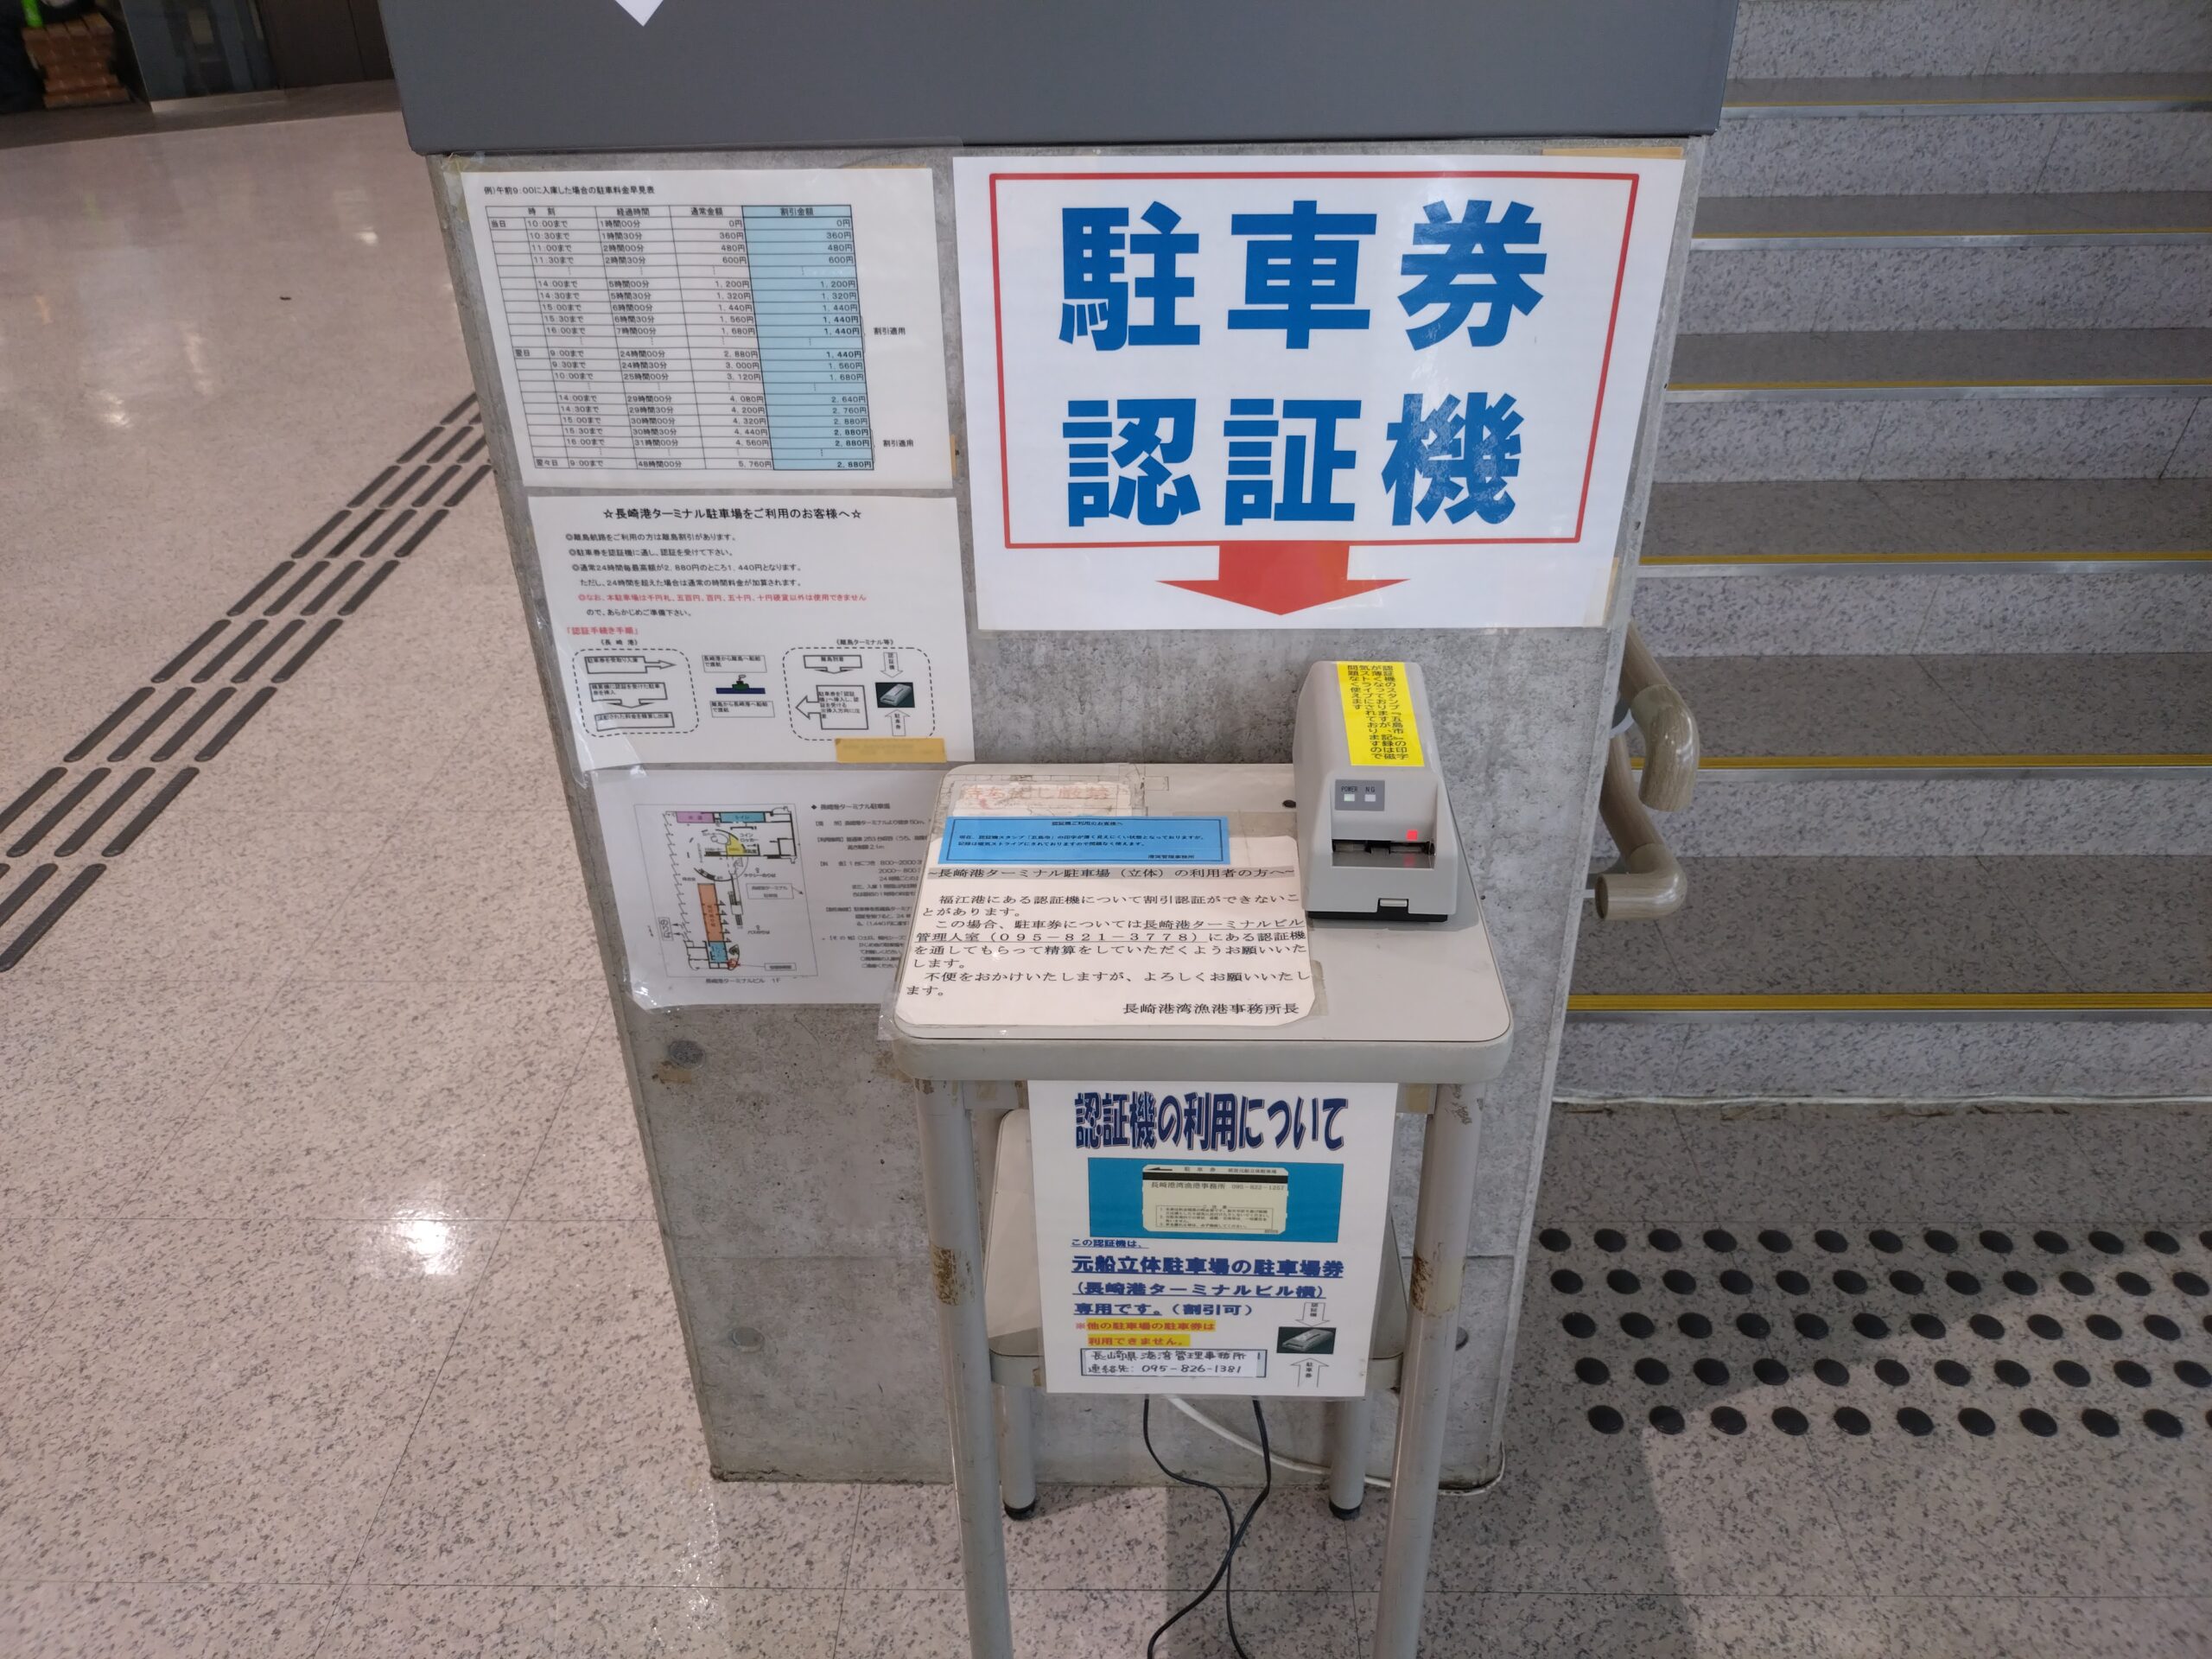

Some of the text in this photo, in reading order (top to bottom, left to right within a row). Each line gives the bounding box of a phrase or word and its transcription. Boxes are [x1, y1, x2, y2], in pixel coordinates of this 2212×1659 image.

[691, 207, 723, 216] 通常金額
[780, 207, 814, 216] 割引金額
[1058, 200, 1548, 351] 駐車券
[608, 280, 649, 289] 5時間00分
[610, 292, 652, 301] 5時間30分
[616, 327, 656, 335] 7時間00分
[874, 327, 906, 335] 割引適用
[634, 438, 678, 447] 31時間00分
[883, 439, 914, 448] 割引適用
[1062, 391, 1524, 526] 認証機
[939, 894, 1300, 906] 福江港にある認証機について割引認証ができないこ
[923, 907, 1020, 917] とがあります。
[914, 958, 966, 969] します。
[906, 986, 944, 996] ます。
[1122, 1003, 1300, 1014] 長崎港湾漁港事務所長
[1074, 1091, 1349, 1152] 認証機の利用について
[1071, 1239, 1142, 1249] この認証機は、
[1072, 1255, 1344, 1278] 元船立体駐車場の駐車場券
[1088, 1337, 1184, 1345] 利用できません。
[1141, 1363, 1242, 1374] 095-826-1381
